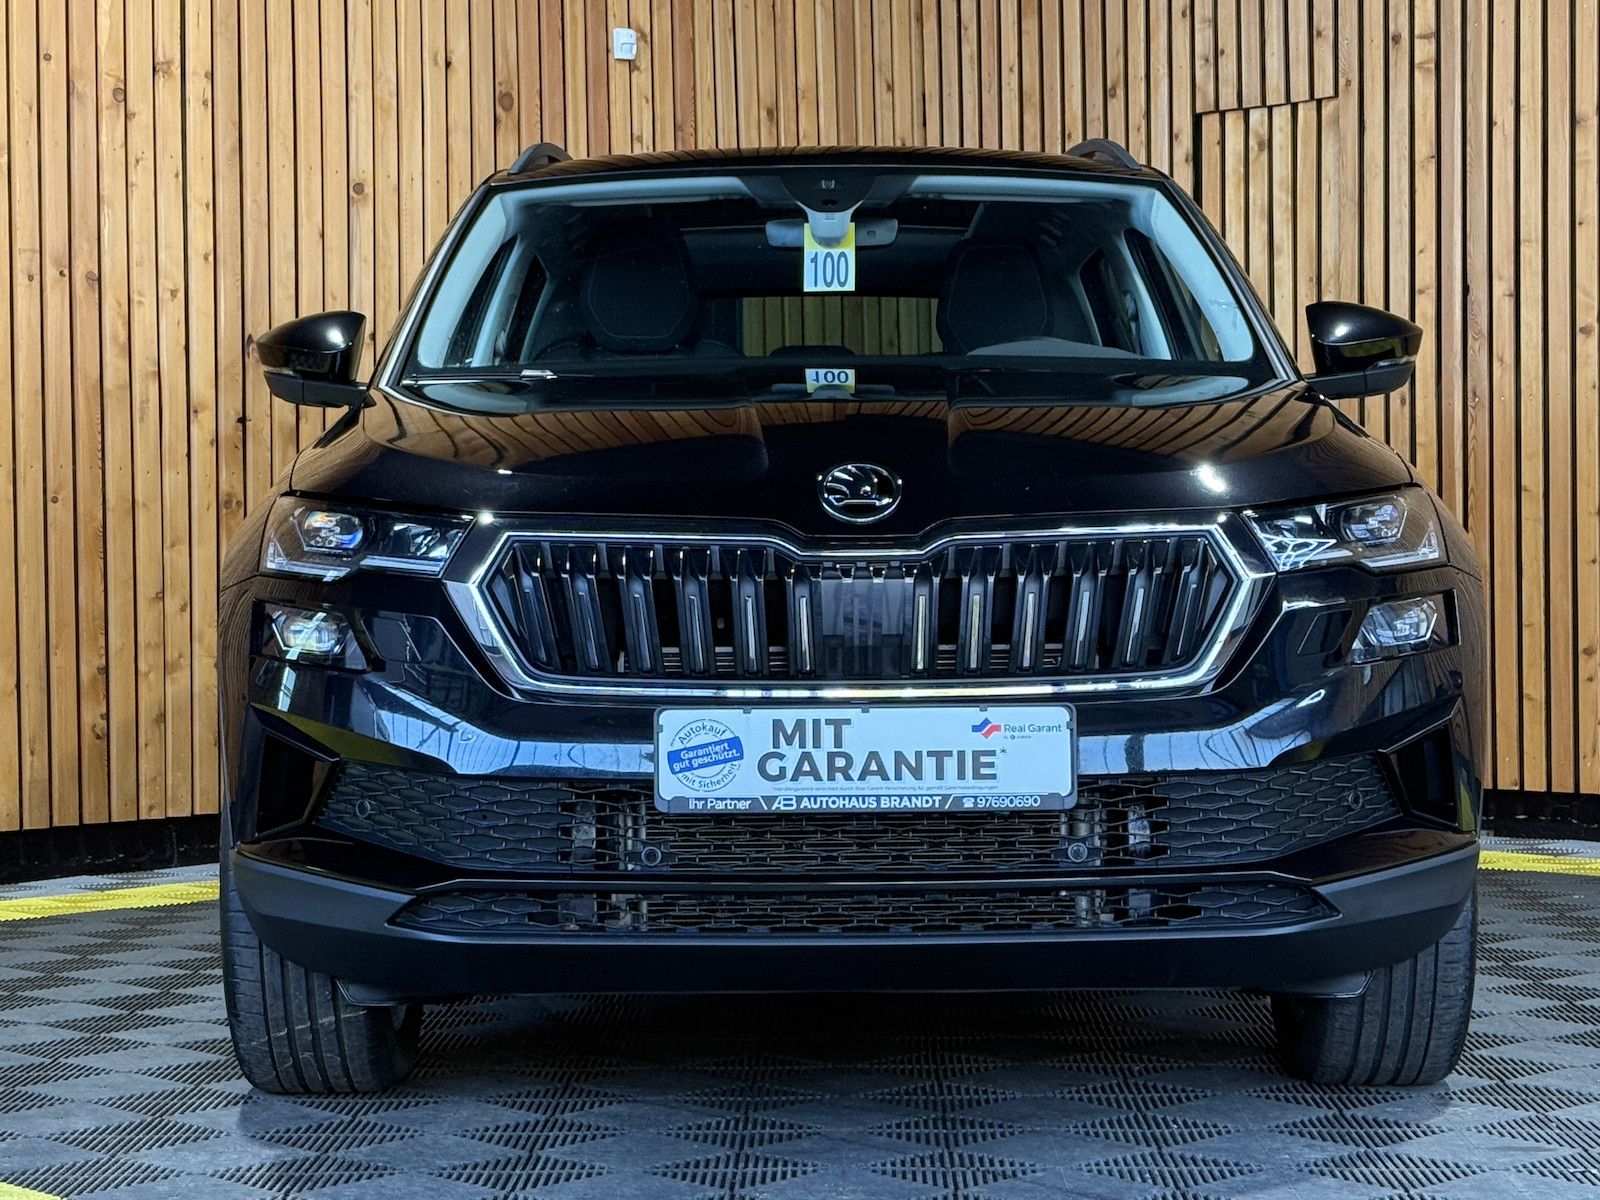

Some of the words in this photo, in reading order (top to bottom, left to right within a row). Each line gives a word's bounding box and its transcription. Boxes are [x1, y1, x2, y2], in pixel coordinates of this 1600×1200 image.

[810, 251, 849, 288] 100
[679, 722, 728, 745] Autokauf
[772, 718, 852, 749] MIT
[1003, 724, 1026, 733] Real
[1028, 723, 1062, 733] Garant
[680, 742, 730, 760] Garantiert
[672, 760, 691, 772] gut
[681, 773, 696, 786] mit
[698, 763, 737, 789] Sicherheit
[688, 798, 705, 810] Ihr
[707, 798, 752, 810] Partner
[800, 796, 878, 809] AUTOHAUS
[881, 796, 943, 808] BRANDT
[976, 795, 1041, 808] 97690690
